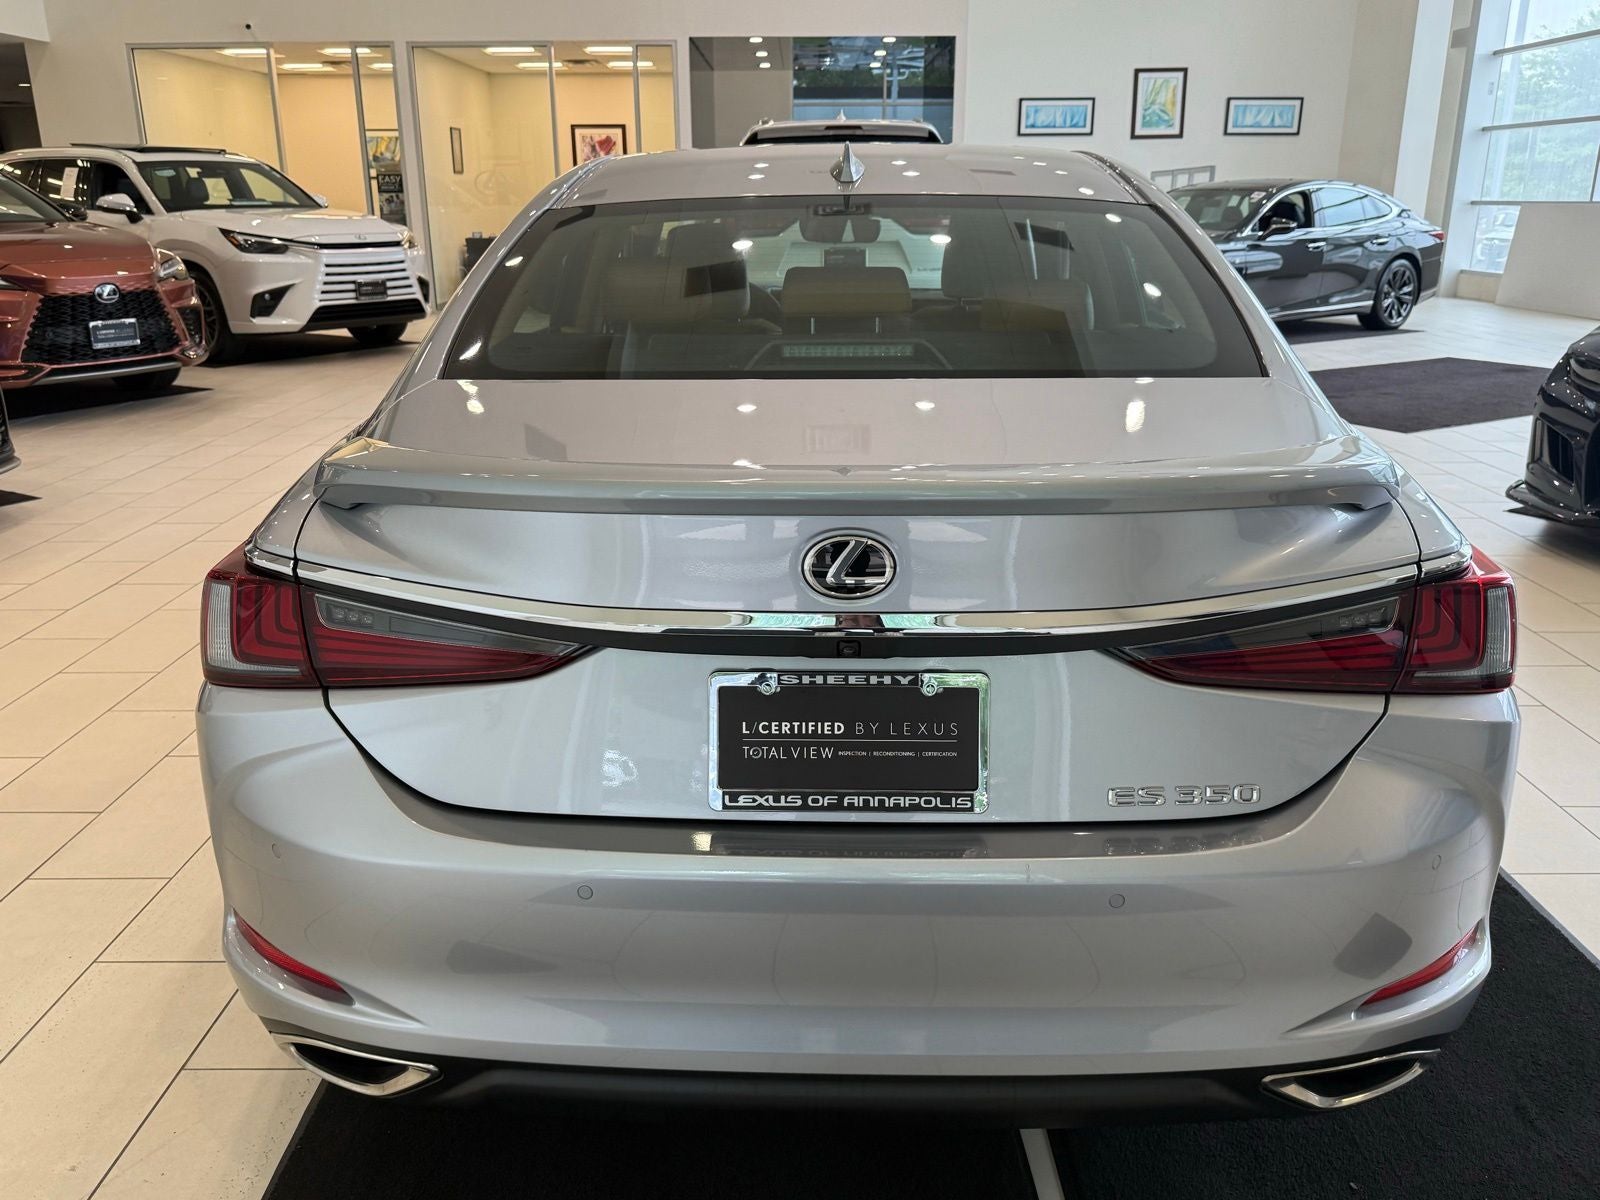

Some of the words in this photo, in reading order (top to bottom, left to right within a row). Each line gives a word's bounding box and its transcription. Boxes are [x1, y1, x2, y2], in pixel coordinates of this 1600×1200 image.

[378, 175, 401, 184] EASY
[779, 674, 916, 685] SHEEHY
[742, 721, 845, 735] L/CERTIFIED
[855, 722, 879, 735] BY
[890, 722, 959, 736] LEXUS
[724, 794, 803, 807] LEXUS
[807, 795, 839, 807] OF
[843, 796, 972, 808] ANNAPOLIS
[1107, 786, 1166, 807] ES
[1175, 784, 1262, 806] 350
